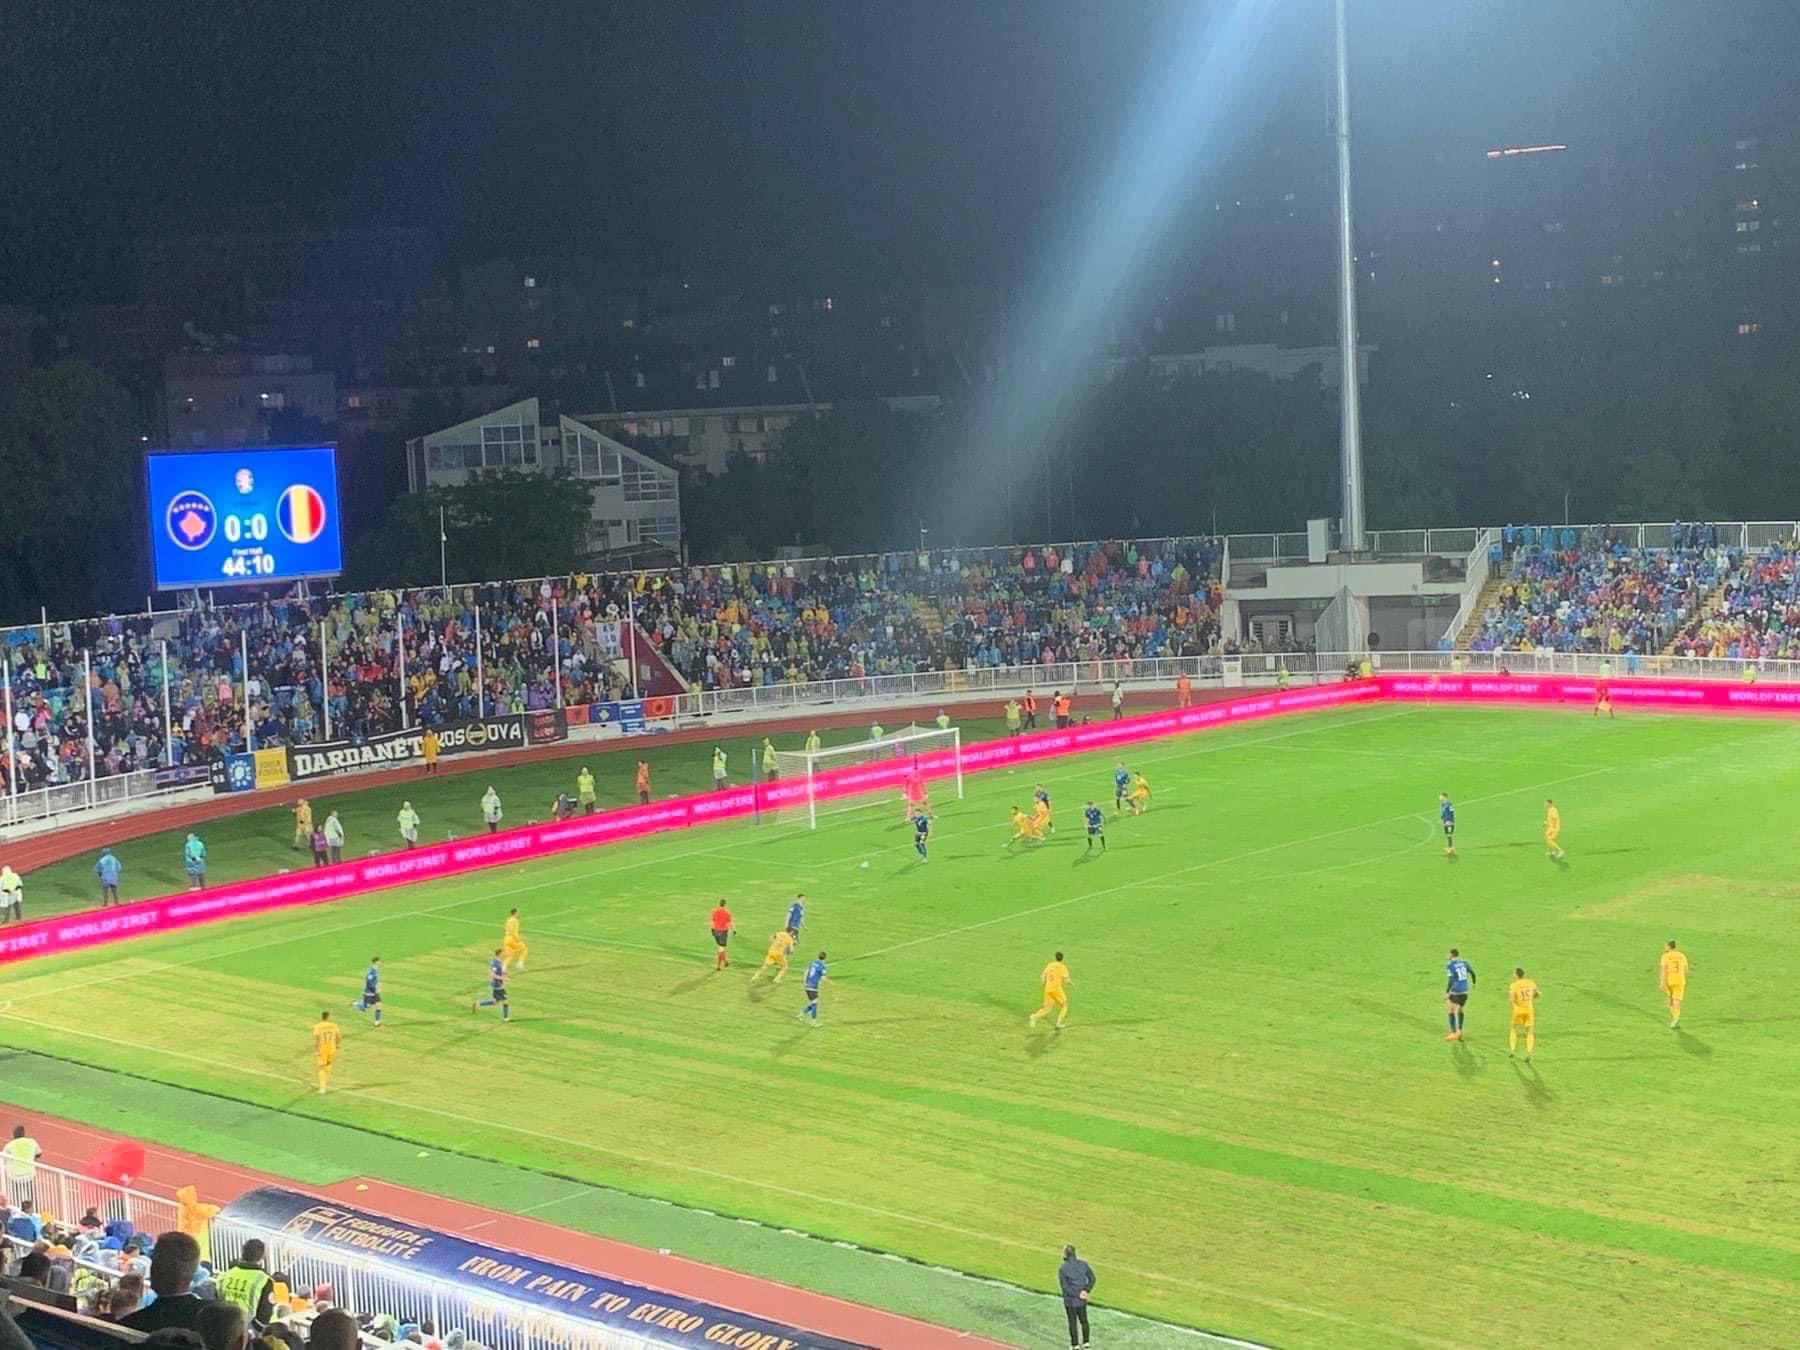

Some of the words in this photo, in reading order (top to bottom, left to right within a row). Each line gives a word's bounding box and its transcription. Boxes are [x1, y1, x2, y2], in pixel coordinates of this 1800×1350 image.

[224, 513, 269, 543] 0:0
[221, 553, 275, 577] 44:10
[455, 837, 533, 862] WORLDFIRST
[363, 853, 447, 880] WORLDFIRST
[58, 911, 158, 941] WORLDFIRST
[457, 1255, 532, 1286] FROM
[524, 1274, 595, 1302] PAIN
[589, 1291, 632, 1313] TO
[627, 1303, 705, 1334] EURO
